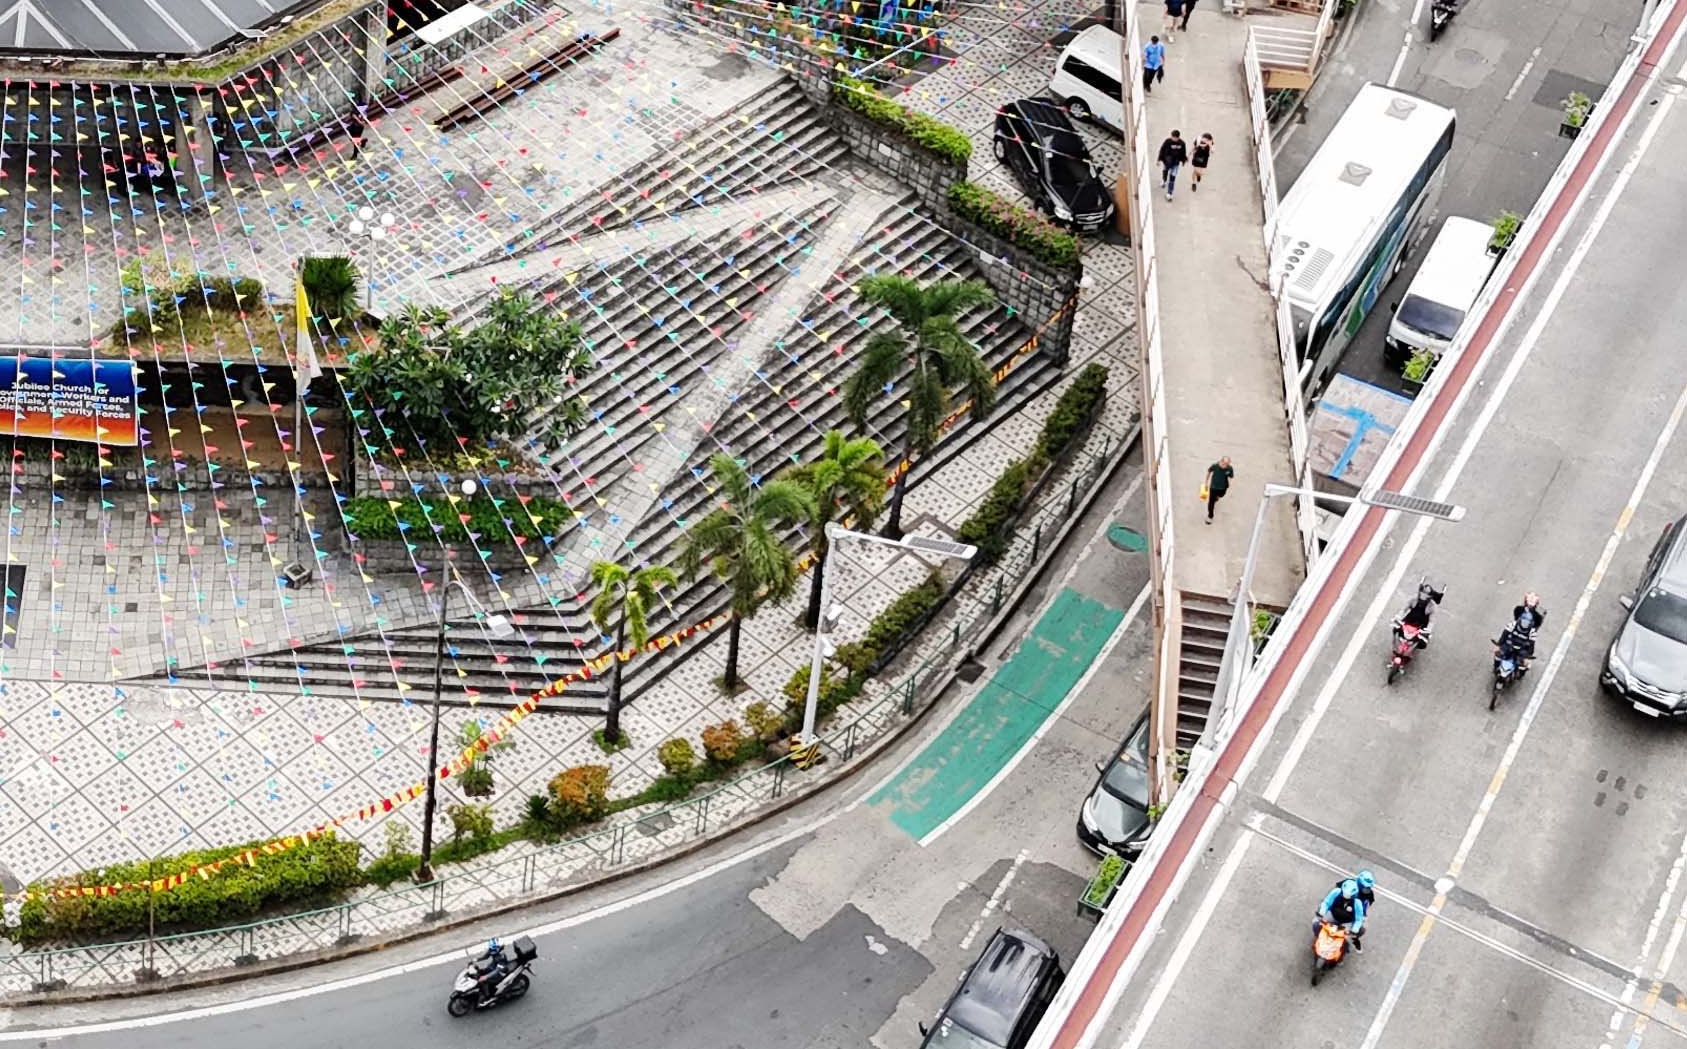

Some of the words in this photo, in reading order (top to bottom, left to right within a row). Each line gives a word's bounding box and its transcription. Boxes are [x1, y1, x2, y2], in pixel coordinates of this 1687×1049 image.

[11, 382, 50, 391] Jubilee
[53, 384, 92, 393] Church
[109, 396, 130, 404] and
